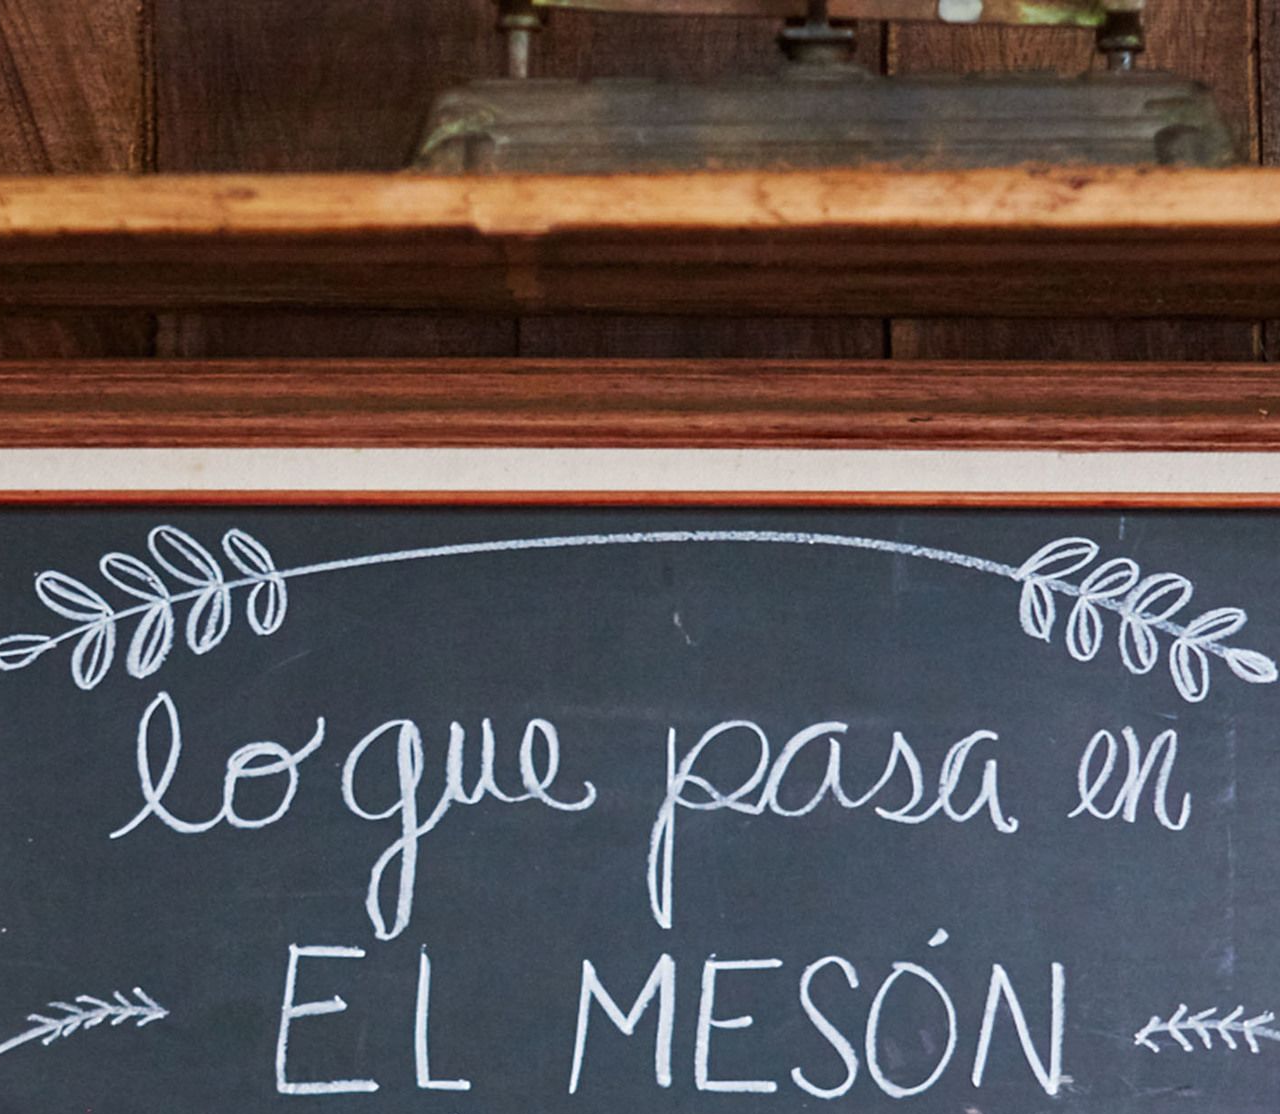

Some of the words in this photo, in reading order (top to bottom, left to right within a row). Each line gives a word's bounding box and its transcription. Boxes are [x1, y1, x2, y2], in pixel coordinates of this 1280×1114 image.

[109, 691, 326, 839] lo
[646, 719, 1020, 930] pasa
[1066, 724, 1192, 831] en
[275, 944, 473, 1094] EL
[568, 928, 1076, 1099] MESÓN
